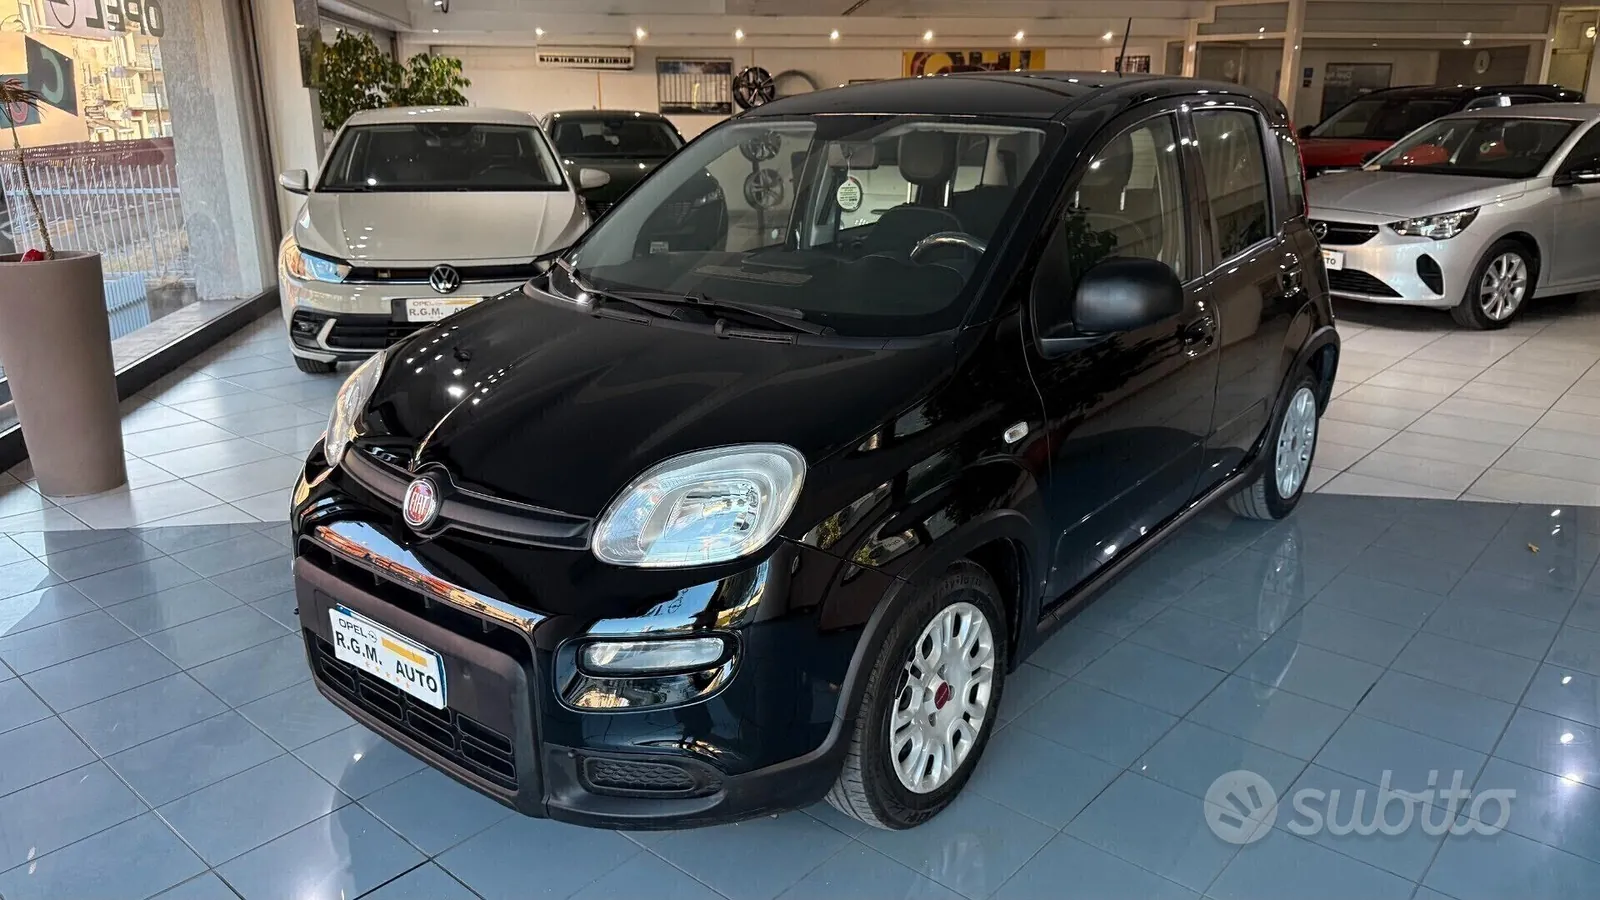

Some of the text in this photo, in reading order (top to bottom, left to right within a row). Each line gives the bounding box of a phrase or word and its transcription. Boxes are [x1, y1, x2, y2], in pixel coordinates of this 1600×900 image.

[1325, 257, 1336, 265] TO
[409, 308, 444, 316] R.G.M.
[409, 491, 430, 515] FIAT
[338, 618, 368, 638] OPEL
[335, 630, 437, 693] R.G.M. AUTO
